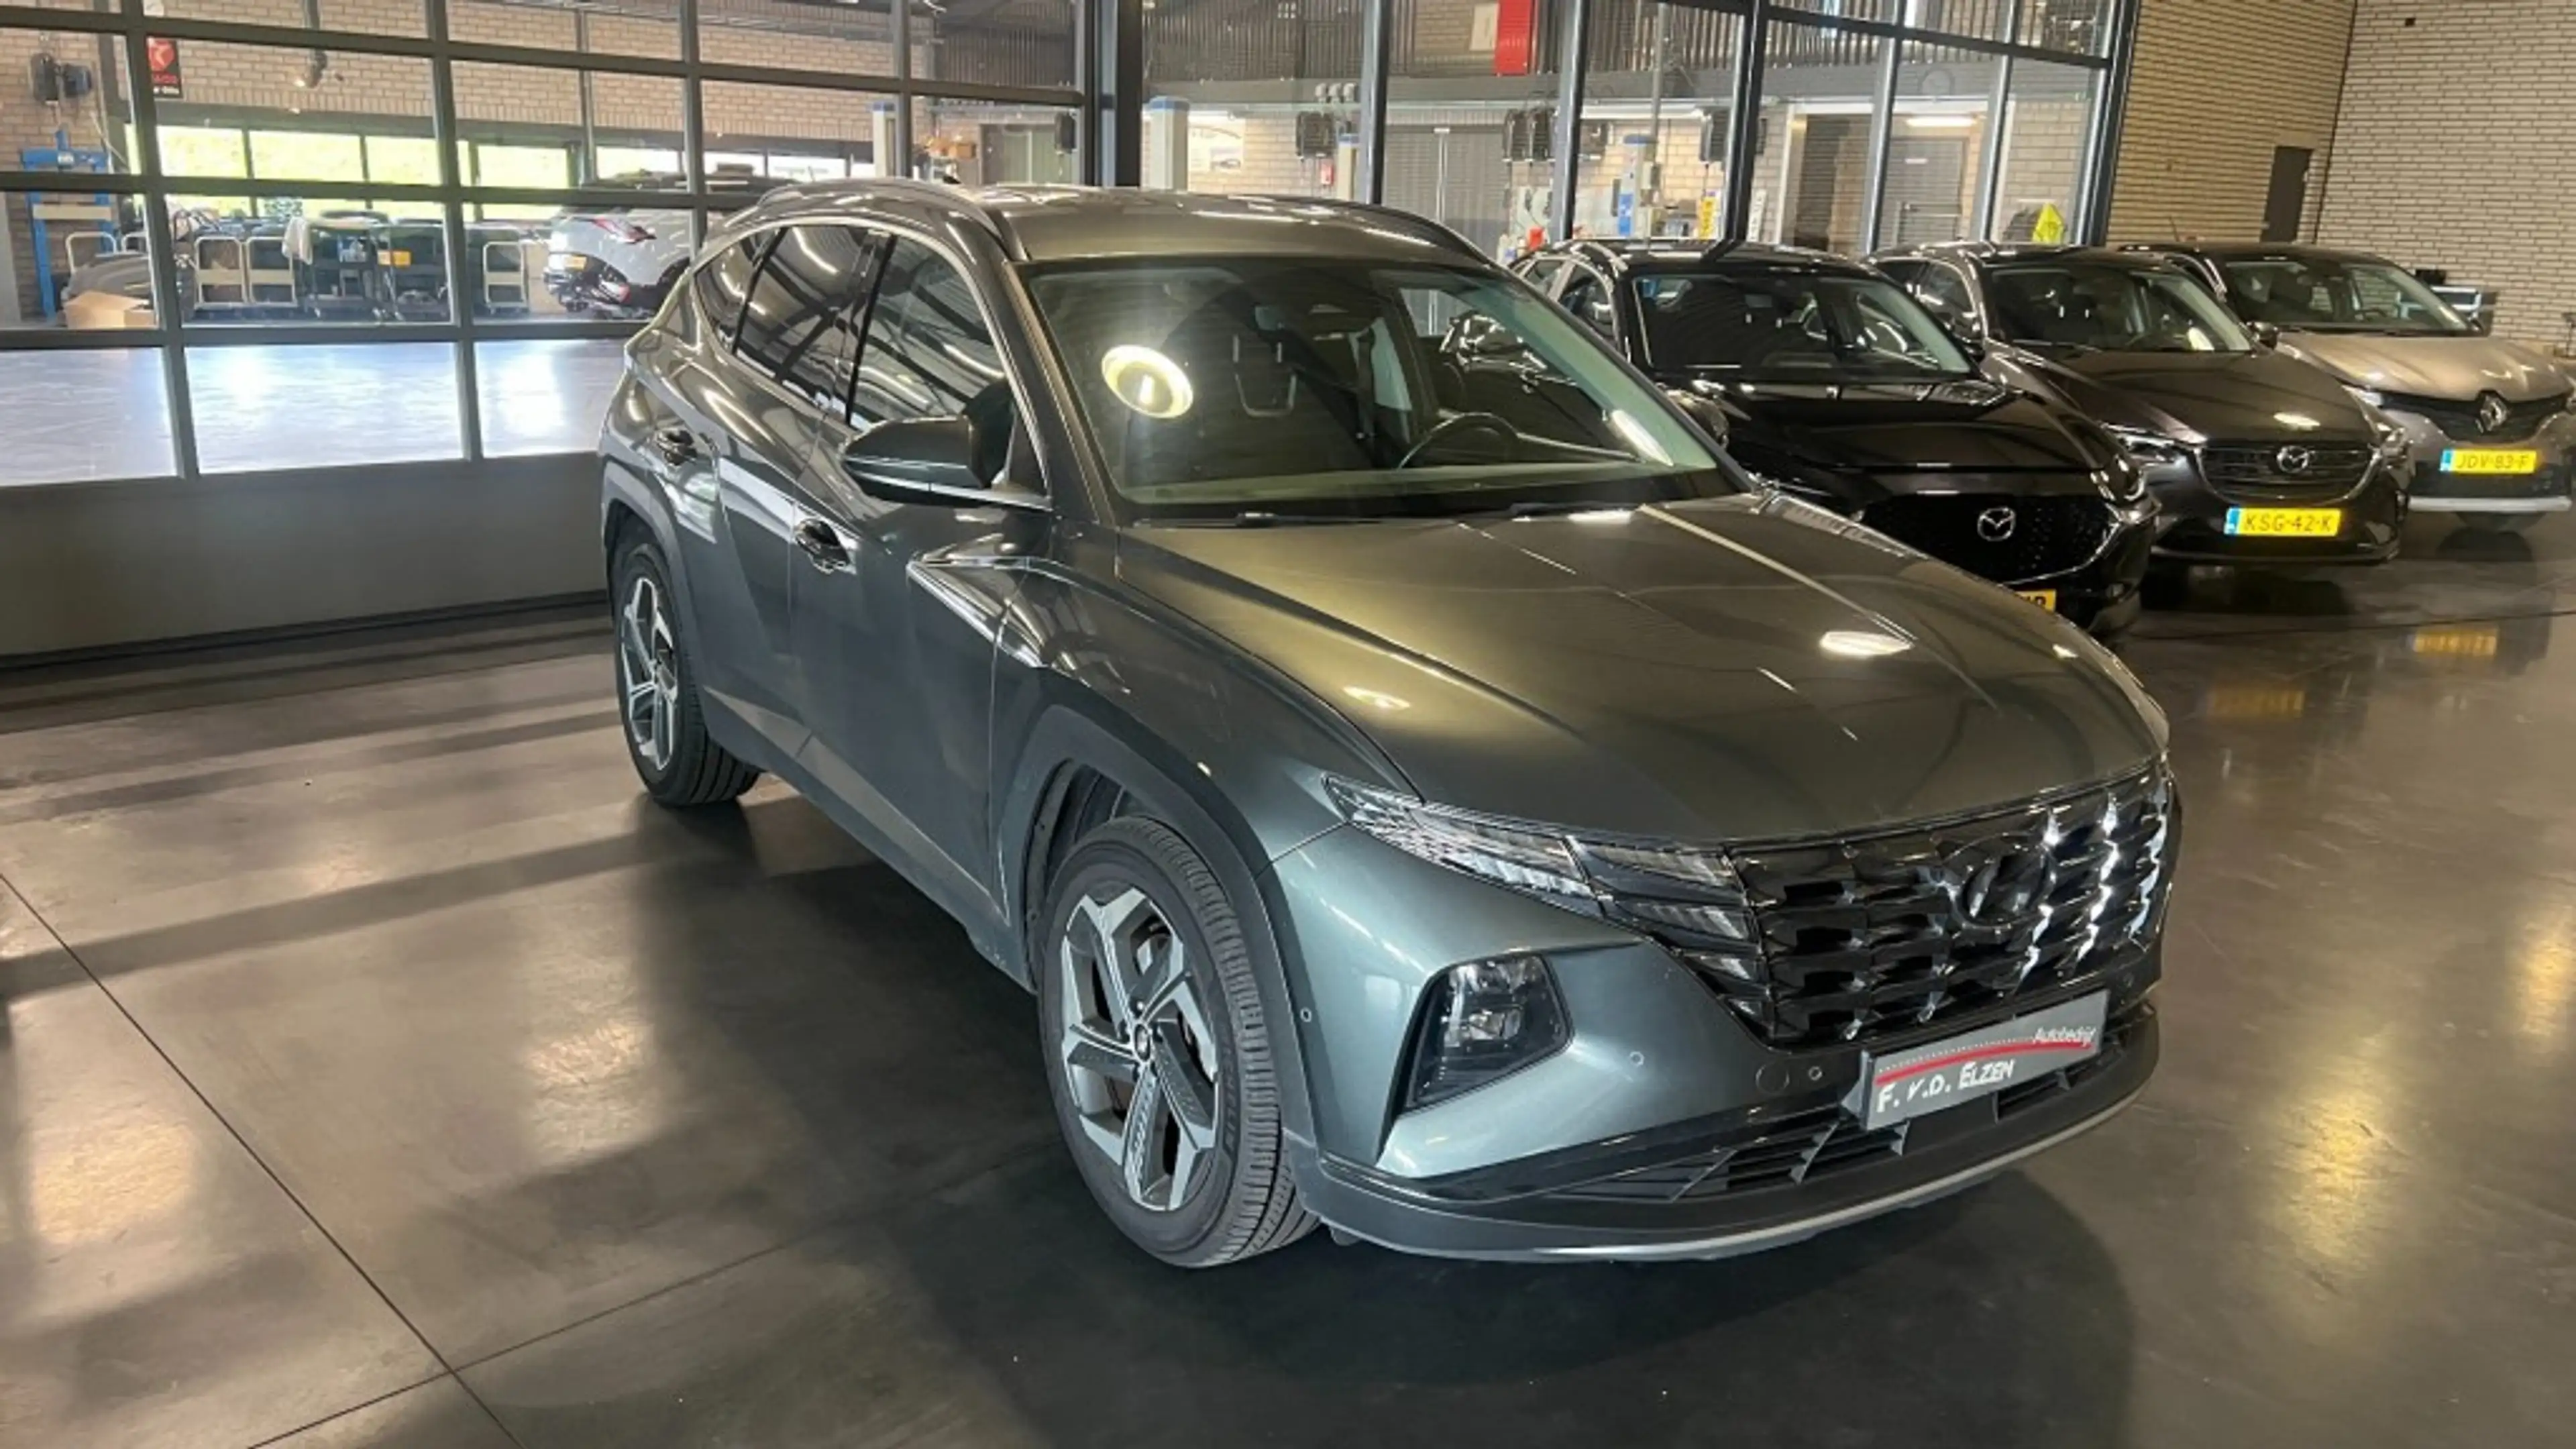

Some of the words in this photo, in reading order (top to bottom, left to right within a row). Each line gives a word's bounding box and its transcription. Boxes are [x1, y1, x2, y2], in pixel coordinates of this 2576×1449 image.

[2455, 453, 2530, 470] JDV-83-F
[2244, 512, 2334, 532] KSG-42-K
[1877, 1082, 1900, 1112] F.
[1957, 1059, 2015, 1089] ELZEN
